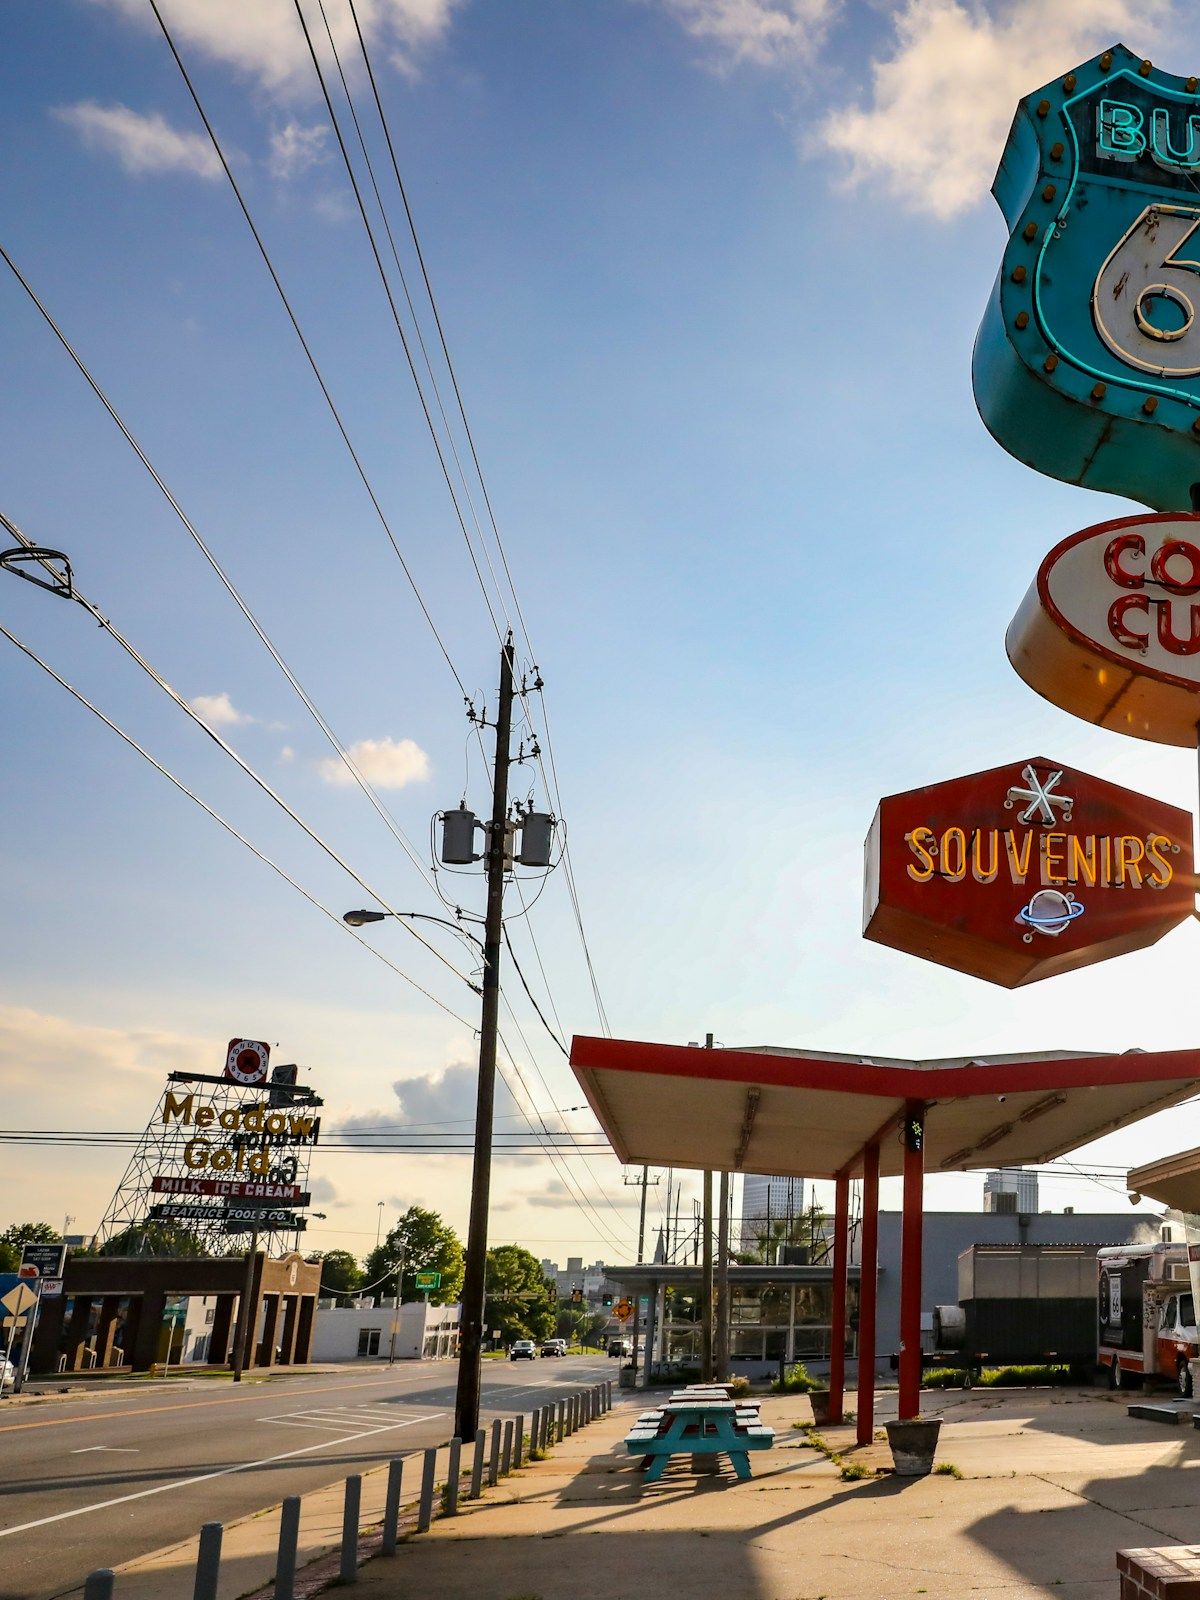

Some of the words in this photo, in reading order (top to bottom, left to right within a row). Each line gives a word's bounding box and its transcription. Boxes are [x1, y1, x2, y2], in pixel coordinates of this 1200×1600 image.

[904, 826, 1174, 889] SOUVENIRS
[162, 1091, 314, 1136] Meadow
[183, 1137, 271, 1176] Gold
[215, 1182, 241, 1195] ICE
[245, 1184, 295, 1198] CREAM
[161, 1206, 224, 1218] BEATRICE
